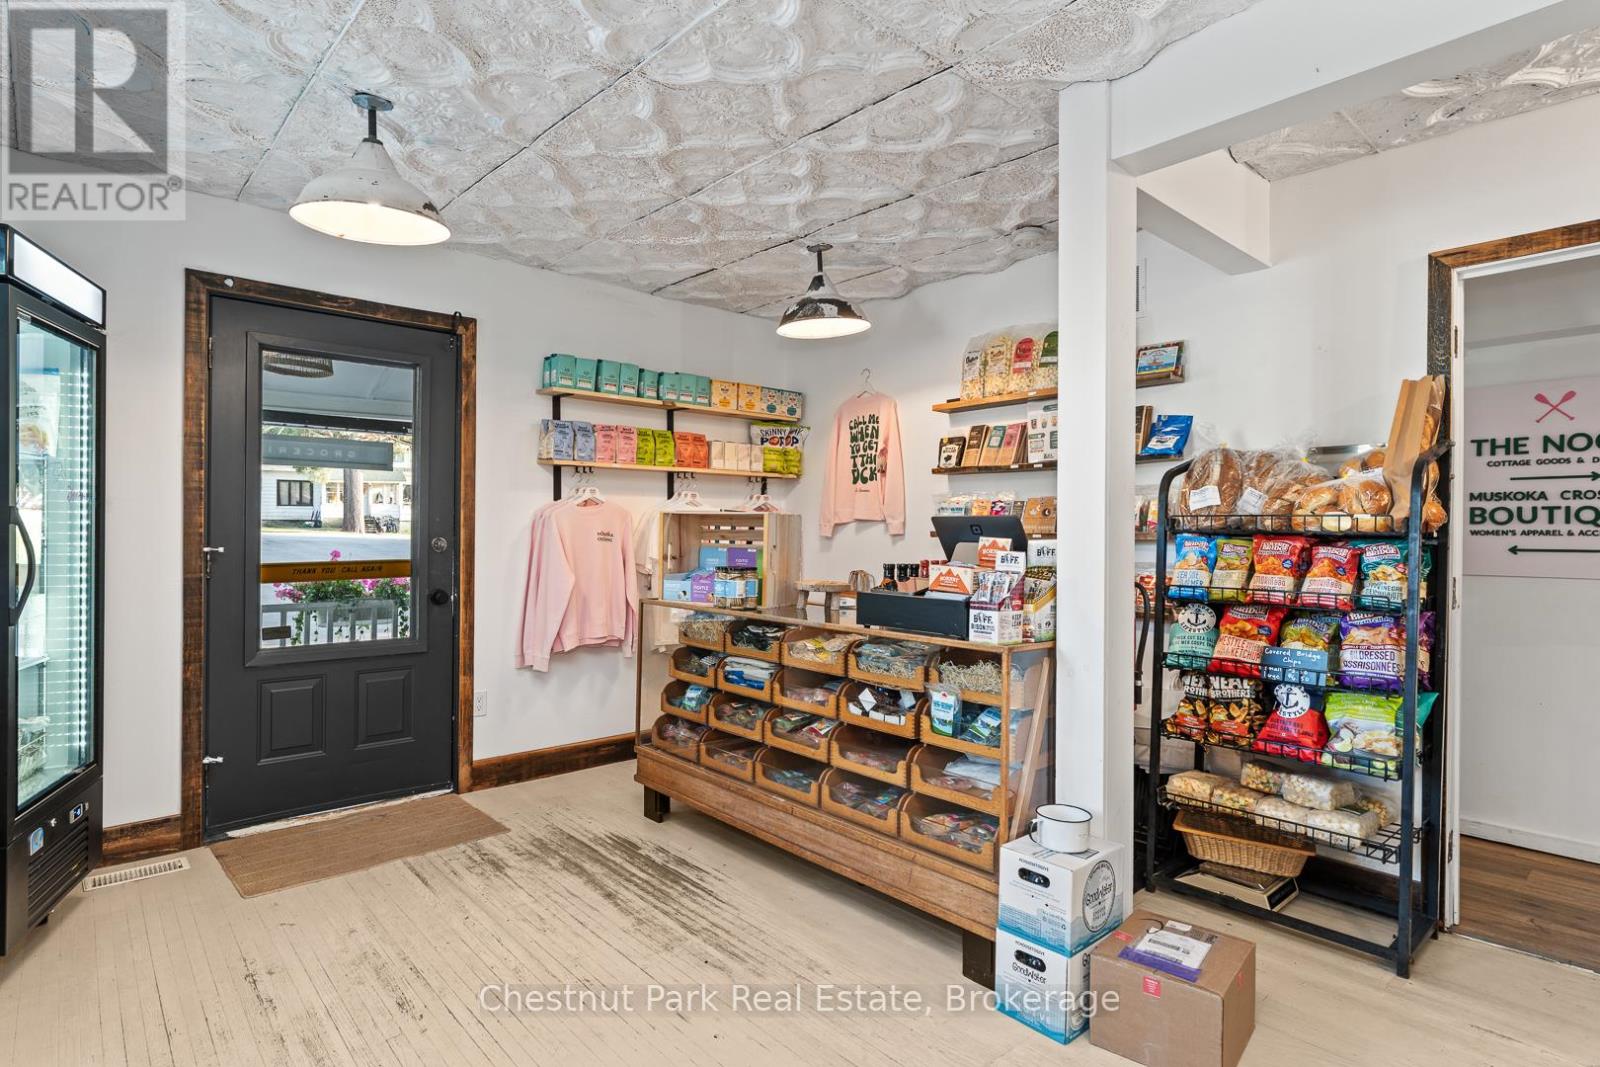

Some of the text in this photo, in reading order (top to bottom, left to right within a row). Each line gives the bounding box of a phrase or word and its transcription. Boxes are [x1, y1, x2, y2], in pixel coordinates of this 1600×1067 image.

[850, 425, 880, 443] WHEN
[1470, 432, 1600, 457] THE NO
[1486, 459, 1531, 467] COTTAGE
[1536, 457, 1571, 465] GOODS
[1576, 456, 1585, 464] &
[1469, 490, 1548, 502] MUSKOKA
[1469, 505, 1600, 528] BOUTIQ
[1470, 529, 1517, 537] WOMEN'S
[1520, 529, 1564, 537] APPAREL
[1566, 529, 1575, 537] &
[1264, 647, 1321, 662] Covered Bridge
[1359, 650, 1395, 661] DRESSED
[1210, 675, 1251, 690] NEAL
[1210, 688, 1251, 698] BROTHERS
